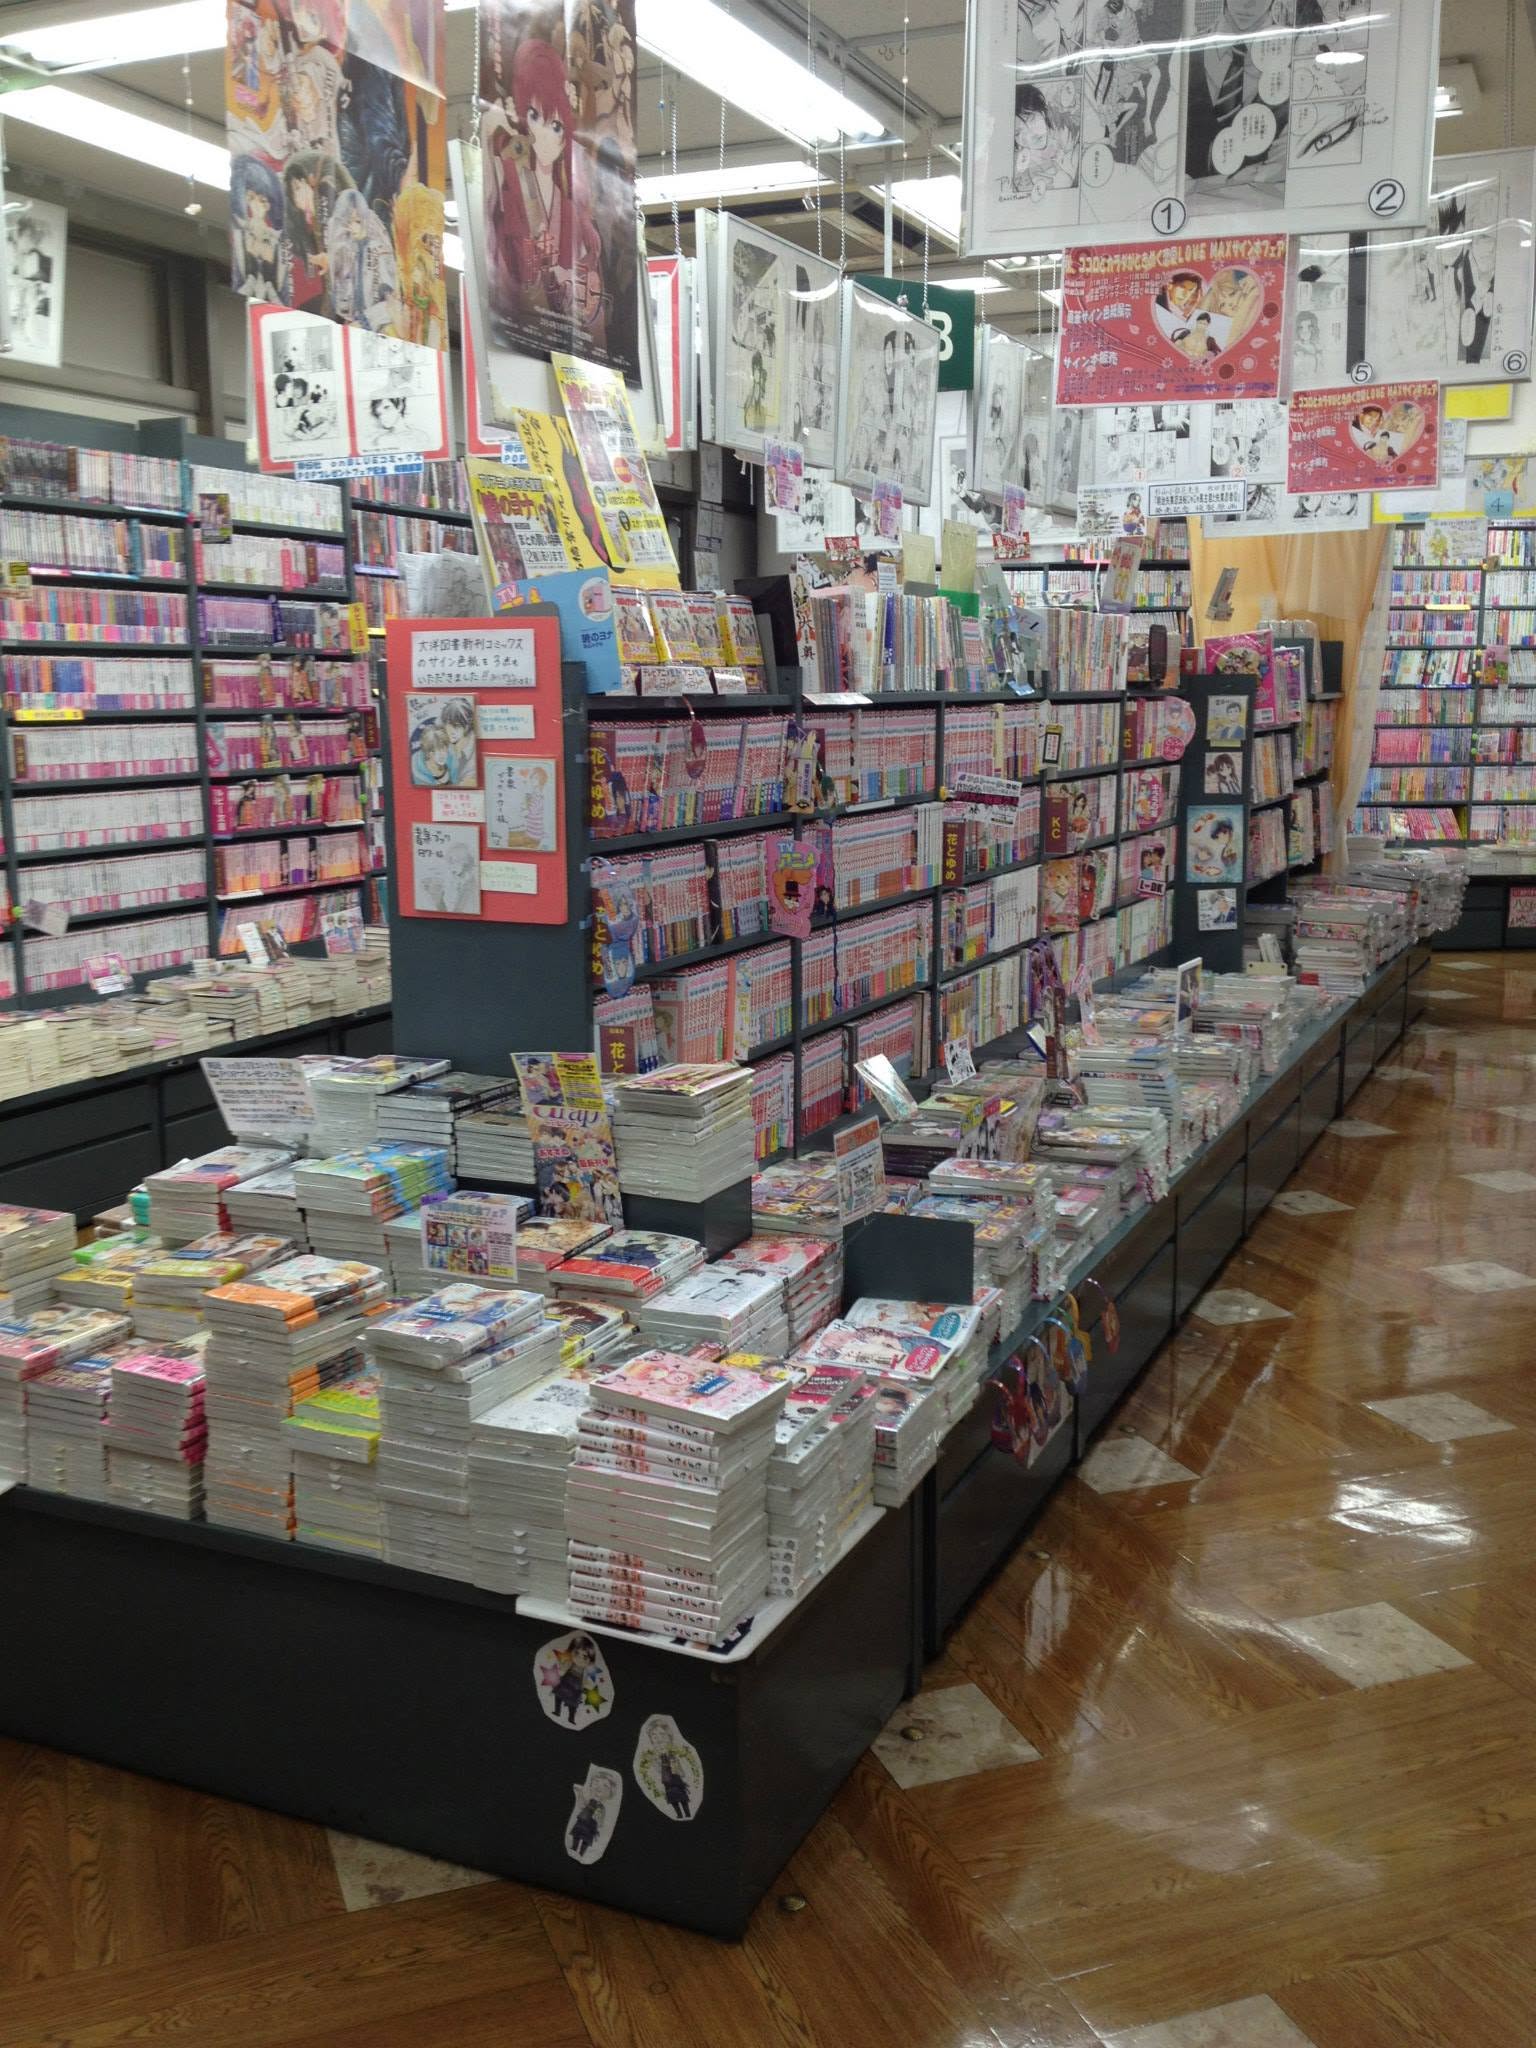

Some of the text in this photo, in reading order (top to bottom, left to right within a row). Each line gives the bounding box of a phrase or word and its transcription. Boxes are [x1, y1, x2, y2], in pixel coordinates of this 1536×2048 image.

[1051, 816, 1061, 839] KC
[945, 833, 958, 880] 花とゆめ
